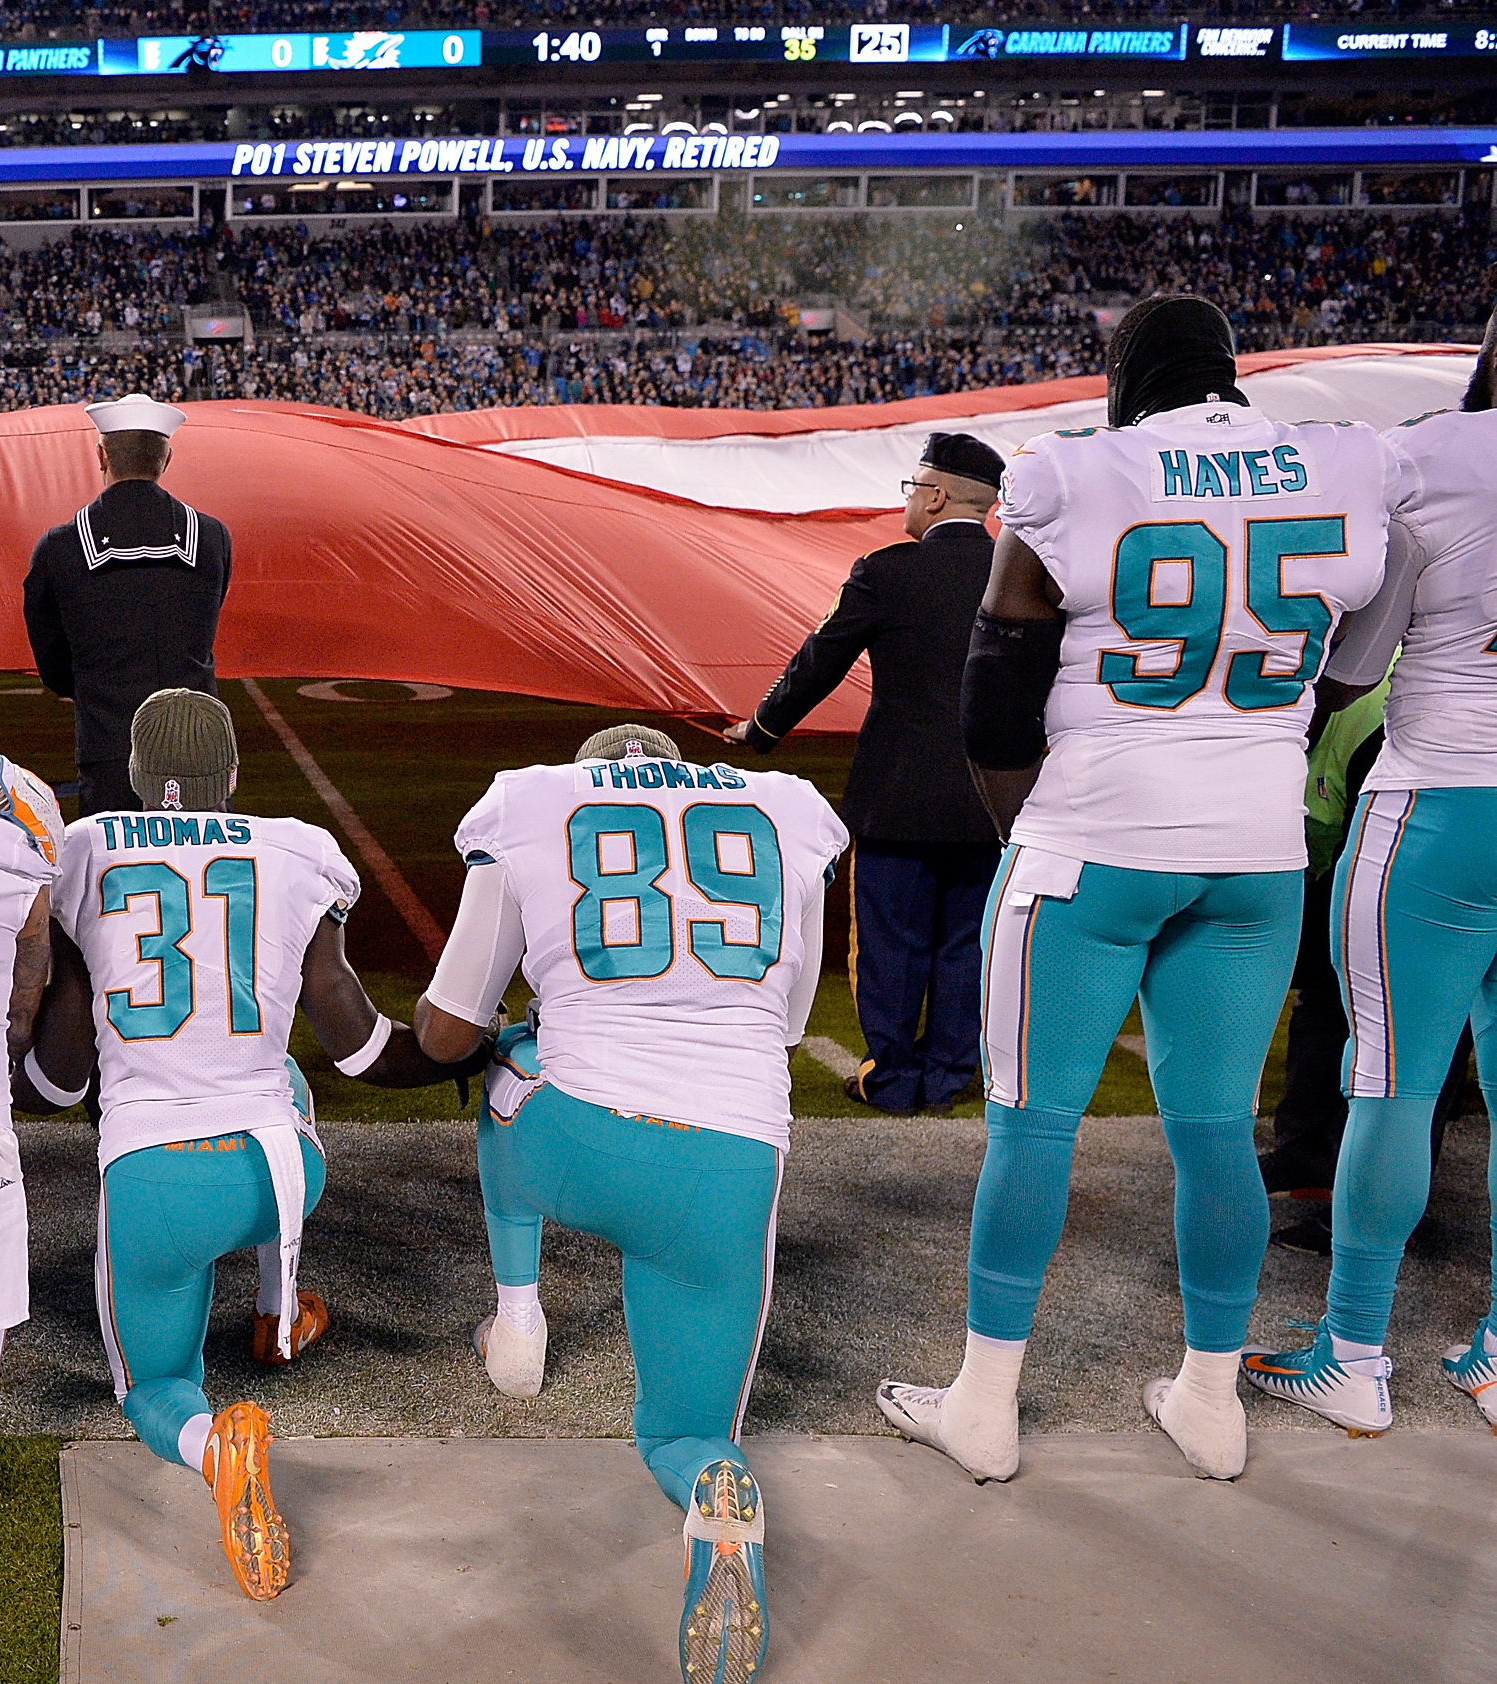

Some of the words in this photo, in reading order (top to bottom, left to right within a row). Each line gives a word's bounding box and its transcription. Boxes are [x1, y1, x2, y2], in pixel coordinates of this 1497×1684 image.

[271, 39, 293, 68] 0
[443, 35, 464, 65] 0
[533, 31, 602, 62] 1:40
[651, 41, 662, 57] 1
[784, 38, 816, 61] 35
[859, 31, 901, 54] 25
[1005, 31, 1088, 54] CAROLINA
[1088, 31, 1174, 54] PANTHERS
[1337, 34, 1408, 50] CURRENT
[1410, 33, 1448, 48] TIME
[1474, 29, 1497, 50] 8:
[6, 47, 91, 70] PANTHERS
[293, 141, 395, 175] STEVEN
[398, 139, 514, 173] POWELL,
[522, 138, 573, 171] U.S.
[581, 136, 655, 171] NAVY,
[662, 135, 780, 169] RETIRED
[1158, 444, 1308, 498] HAYES
[1096, 513, 1349, 714] 95
[583, 762, 746, 790] THOMAS
[96, 816, 251, 850] THOMAS
[565, 801, 783, 985] 89
[99, 856, 264, 1043] 31
[164, 1138, 246, 1152] MIAMI
